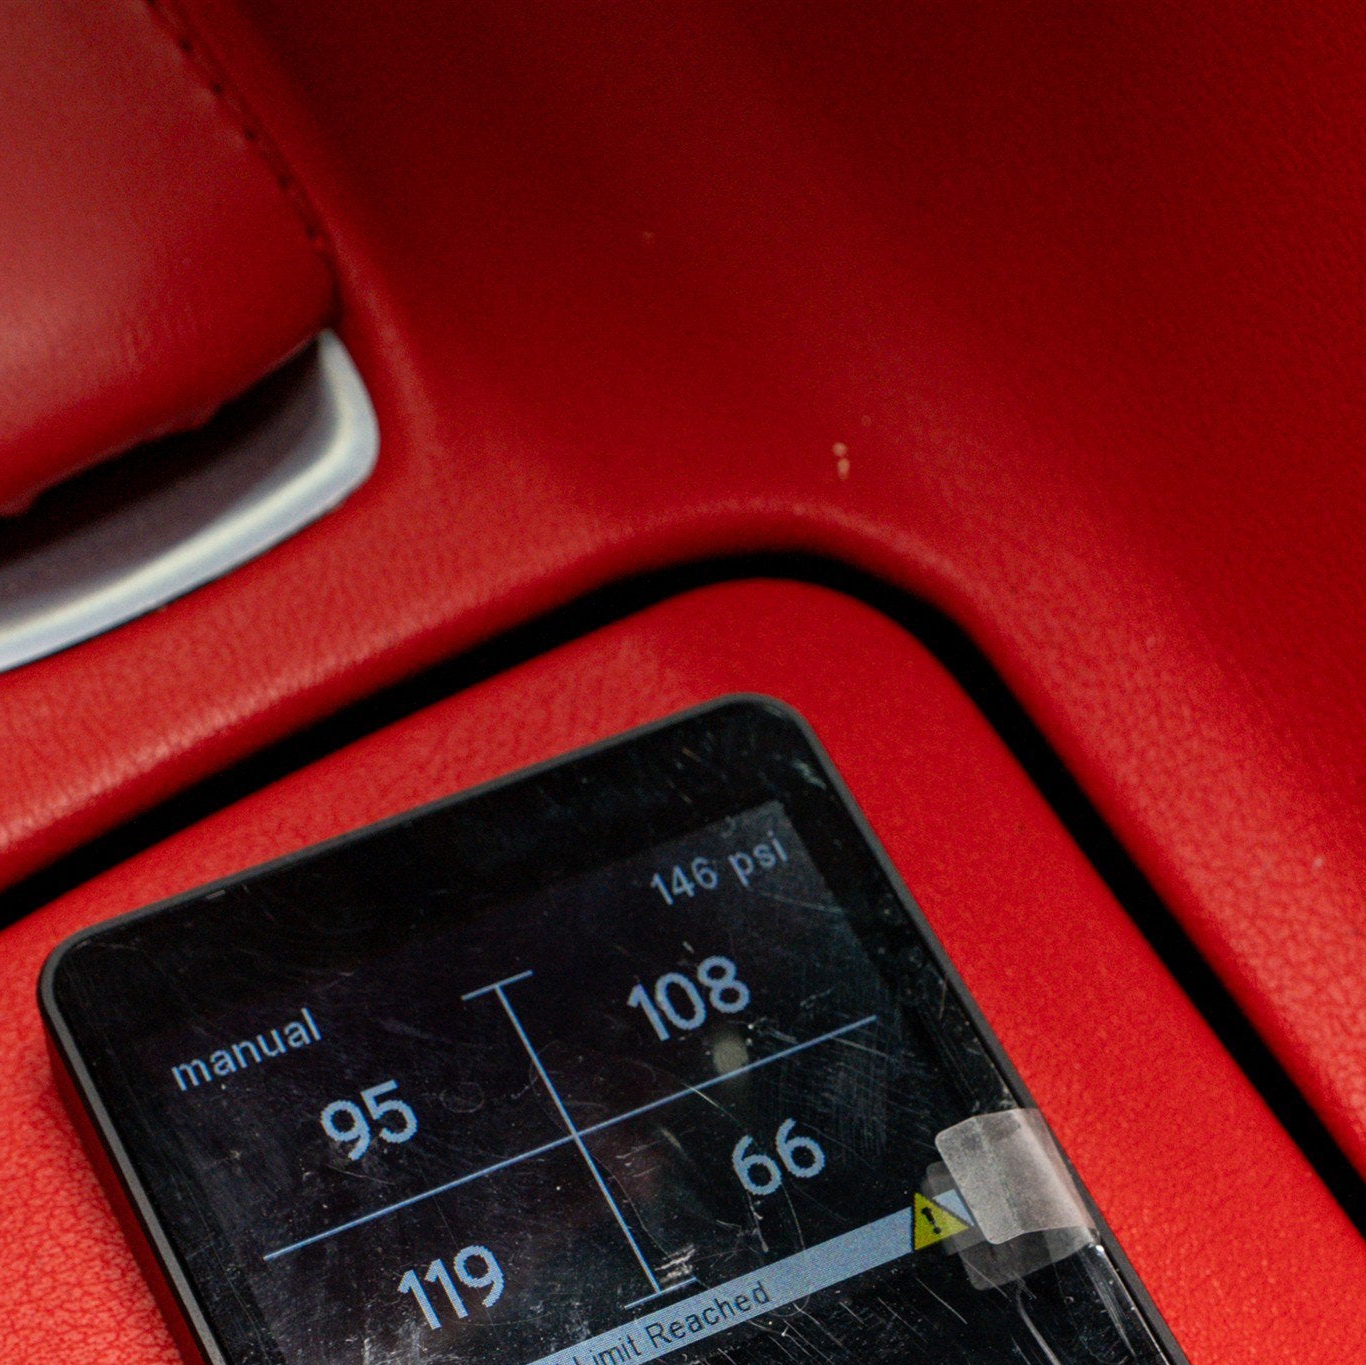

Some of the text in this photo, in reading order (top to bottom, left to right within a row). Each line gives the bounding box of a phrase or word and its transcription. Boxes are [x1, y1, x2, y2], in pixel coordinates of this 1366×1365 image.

[650, 830, 789, 905] 146 psi
[627, 956, 751, 1041] 108
[170, 1007, 323, 1091] manual
[320, 1079, 418, 1161] 95
[732, 1117, 825, 1196] 66
[397, 1245, 504, 1330] 119
[645, 1281, 770, 1349] Reached
